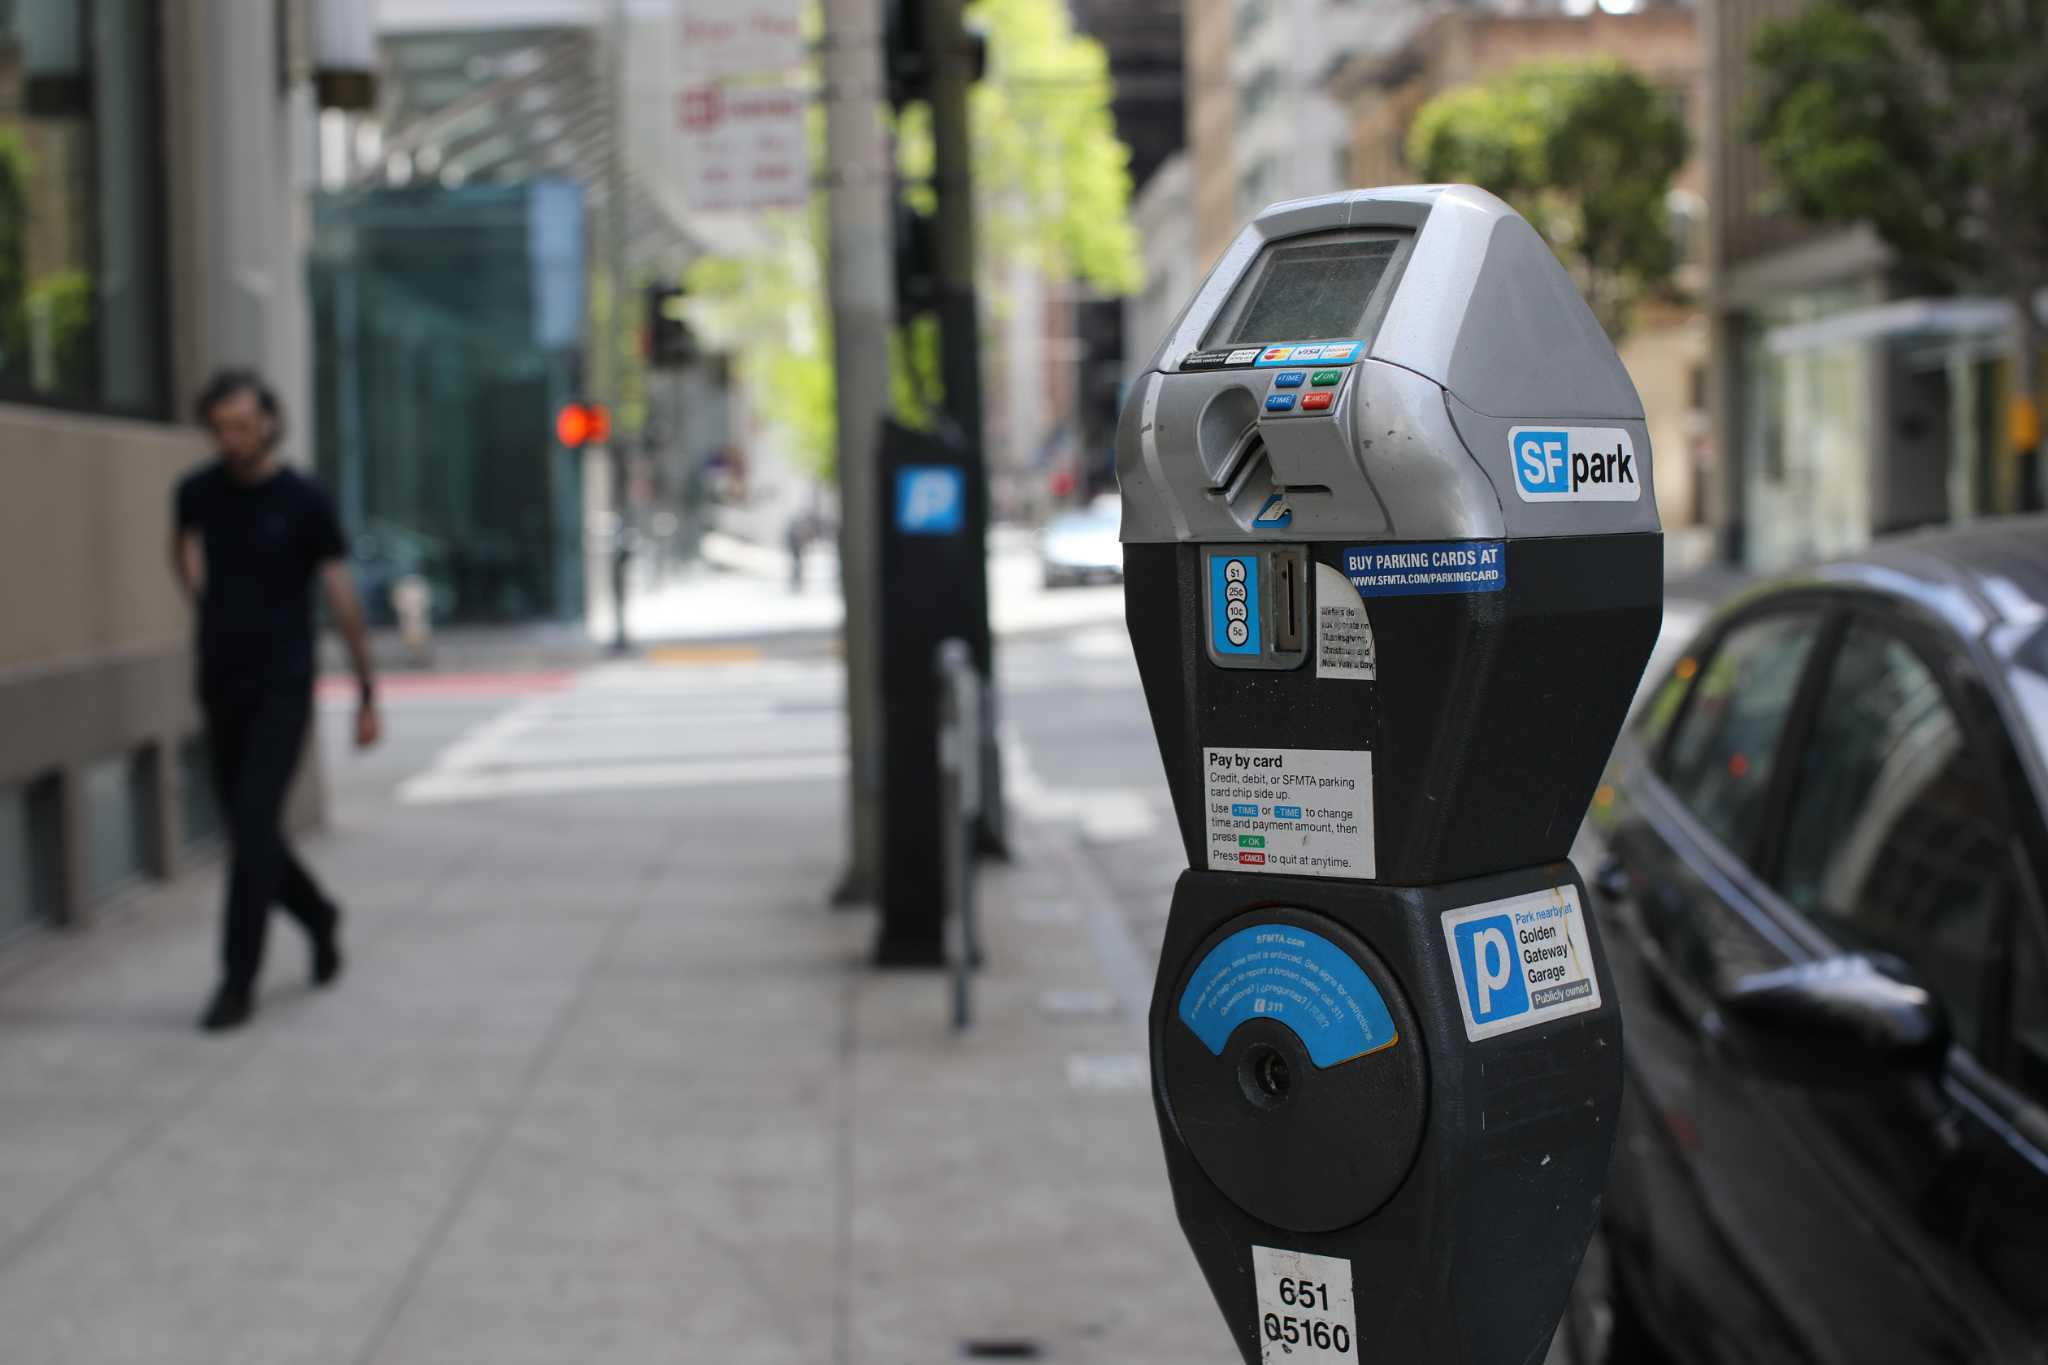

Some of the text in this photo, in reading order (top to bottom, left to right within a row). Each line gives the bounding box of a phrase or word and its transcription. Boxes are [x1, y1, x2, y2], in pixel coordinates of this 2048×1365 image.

[1348, 548, 1499, 571] BUY PARKING CARDS AT
[1350, 570, 1499, 587] WWW.SFMTA.COM/PARKINGCARD
[1210, 752, 1283, 770] Pay by card
[1210, 772, 1355, 790] Credit, debit, or SFMTA parking
[1210, 787, 1290, 801] card chip side up.
[1211, 804, 1229, 814] Use
[1262, 806, 1272, 815] or
[1306, 808, 1316, 818] to
[1318, 808, 1353, 822] change
[1212, 818, 1358, 834] time and payment amount, then
[1212, 833, 1238, 843] press
[1213, 850, 1238, 862] Press
[1268, 854, 1278, 864] to
[1279, 854, 1298, 865] quit
[1300, 856, 1309, 864] at
[1310, 856, 1352, 868] anytime.
[1516, 902, 1572, 925] Park nearby at
[1256, 933, 1305, 948] SFMTA.com
[1519, 926, 1556, 944] Golden
[1524, 943, 1568, 964] Gateway
[1528, 964, 1566, 984] Garage
[1534, 982, 1590, 1004] Publicly owned
[1280, 1277, 1328, 1312] 651
